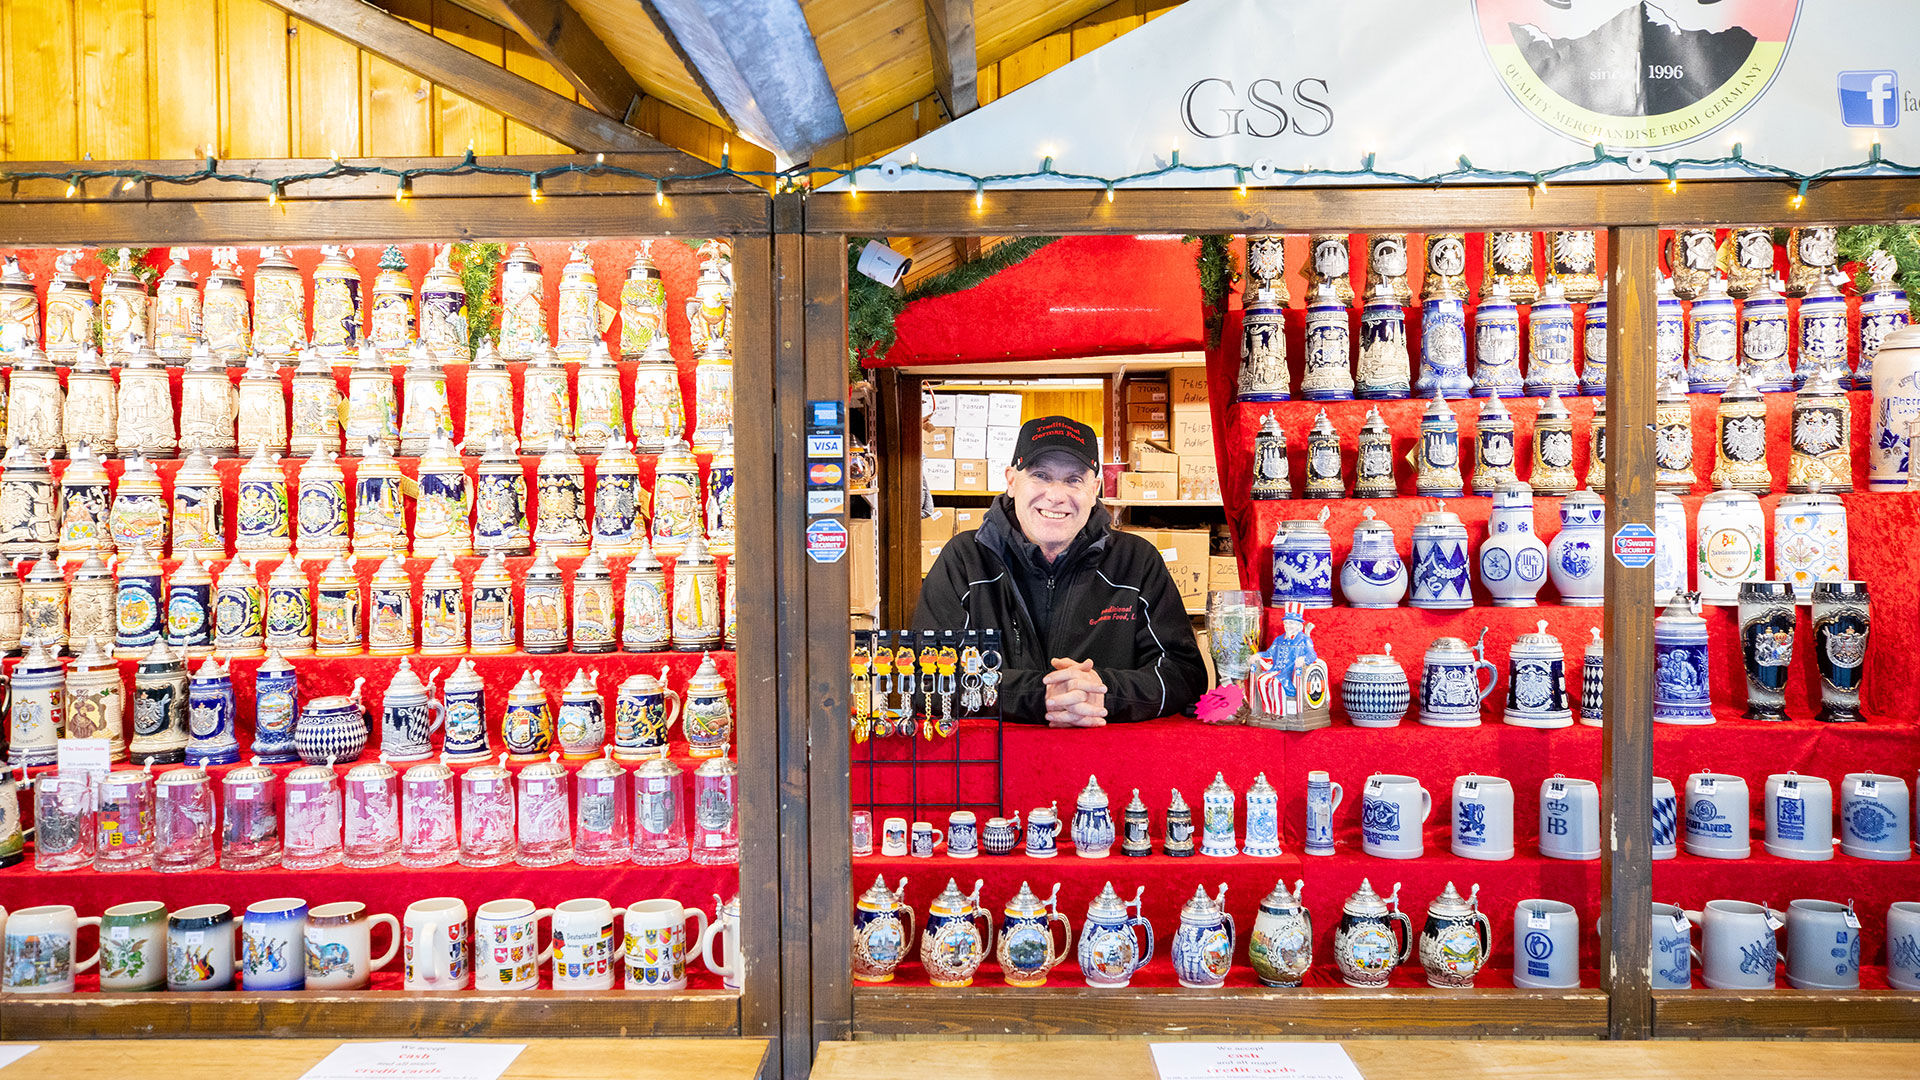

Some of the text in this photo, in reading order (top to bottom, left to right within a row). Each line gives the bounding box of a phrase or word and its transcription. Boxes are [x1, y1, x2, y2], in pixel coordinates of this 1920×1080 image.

[1648, 65, 1684, 80] 1996
[1504, 62, 1763, 141] QUALITY MERCHANDISE FROM GERMANY
[1904, 90, 1920, 112] fa
[1180, 78, 1334, 139] GSS
[1183, 393, 1207, 403] Adler
[1036, 422, 1081, 436] Traditional
[1031, 430, 1085, 445] German Food
[1183, 438, 1209, 448] Adler
[814, 441, 839, 451] VISA
[817, 534, 844, 542] Swann
[1627, 539, 1654, 547] Swann
[1547, 816, 1568, 836] HB
[567, 931, 599, 940] Deutschland
